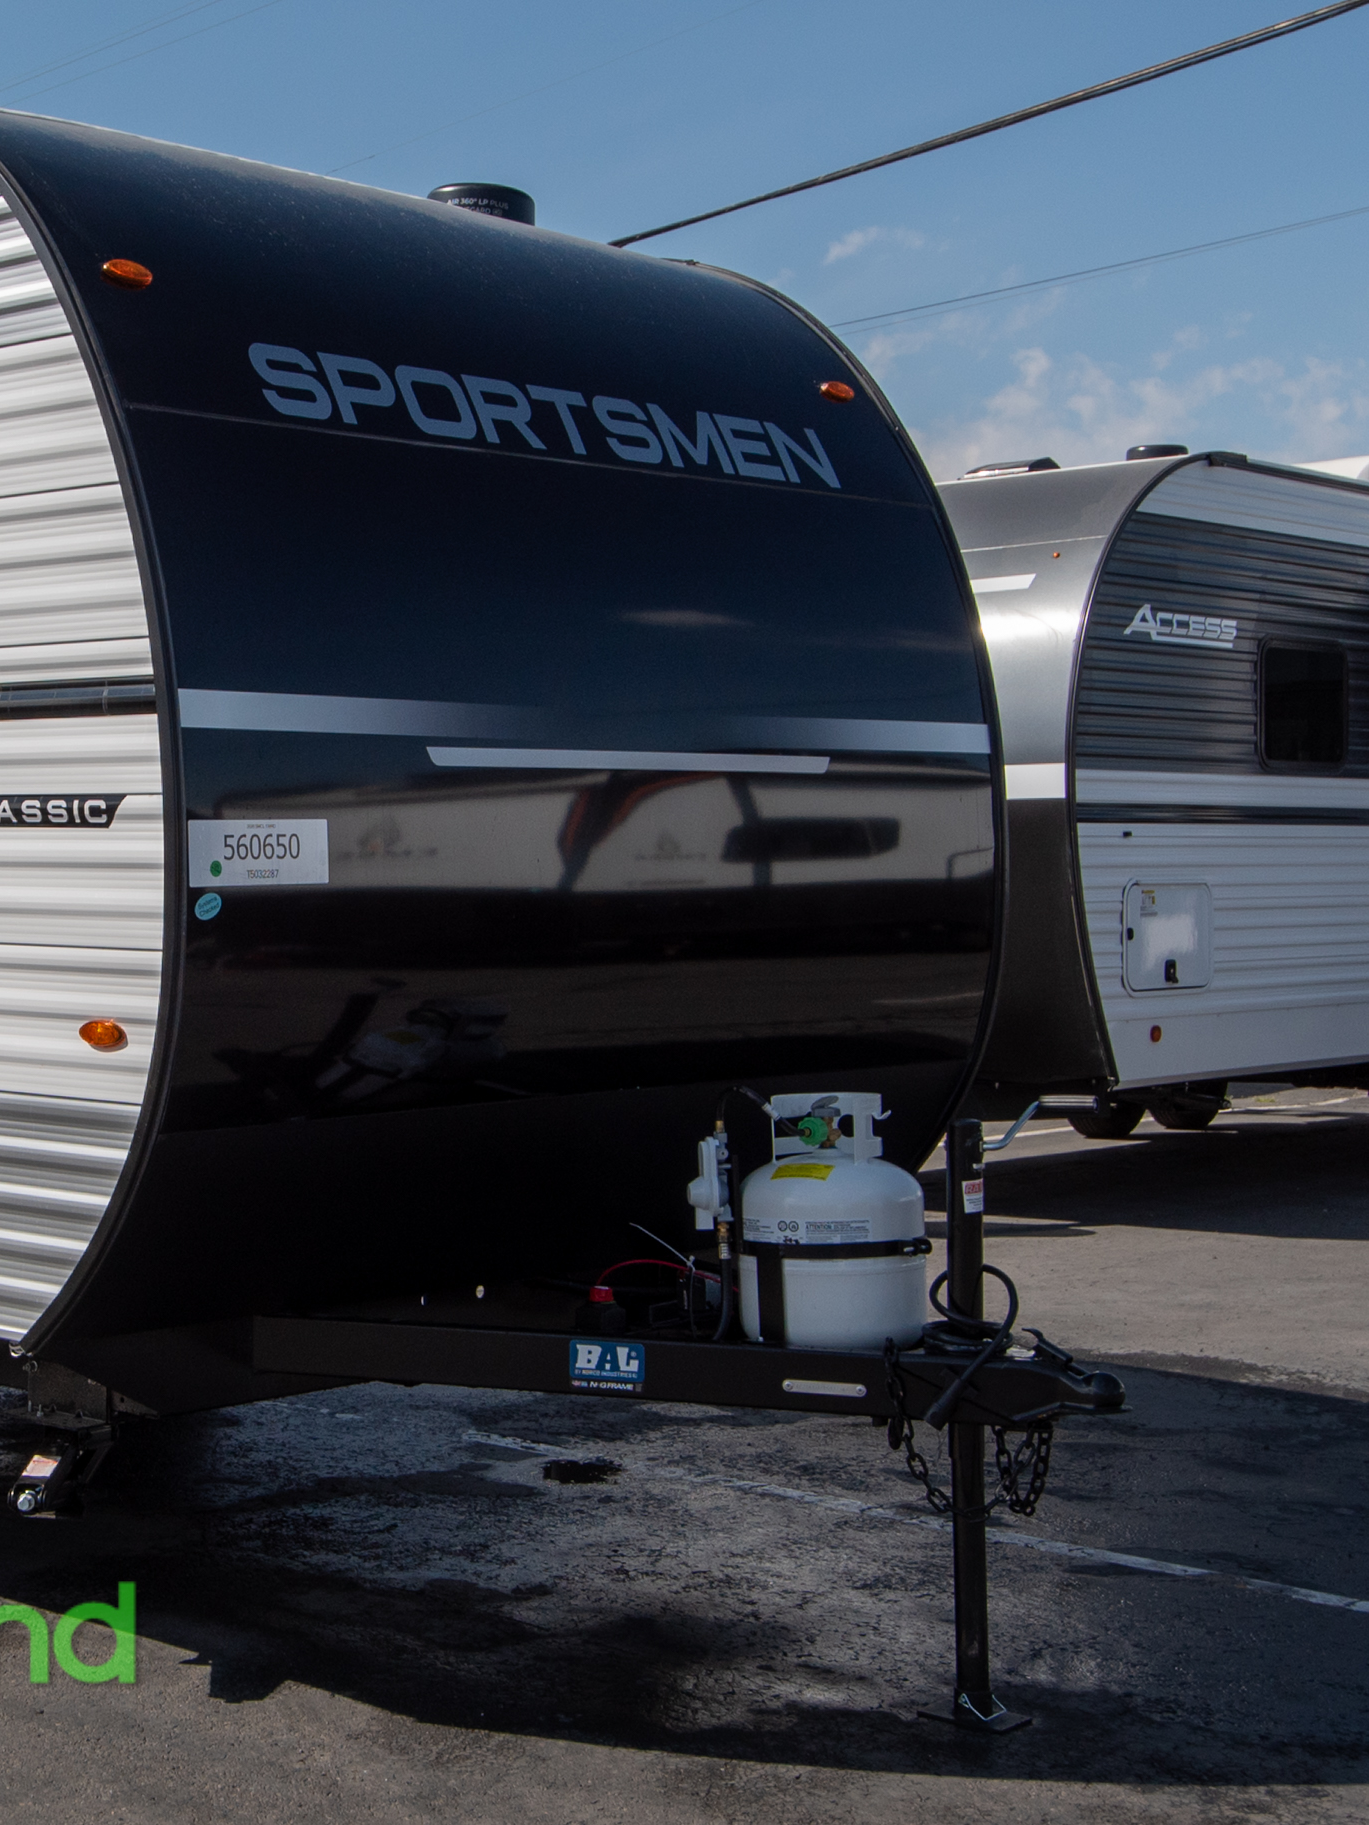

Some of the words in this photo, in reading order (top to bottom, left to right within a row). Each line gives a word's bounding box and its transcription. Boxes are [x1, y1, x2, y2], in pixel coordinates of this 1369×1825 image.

[247, 341, 842, 489] SPORTSMEN
[1123, 604, 1237, 642] ACCESS
[223, 833, 300, 861] 560650
[246, 869, 279, 879] T5032287
[575, 1344, 639, 1372] BAL
